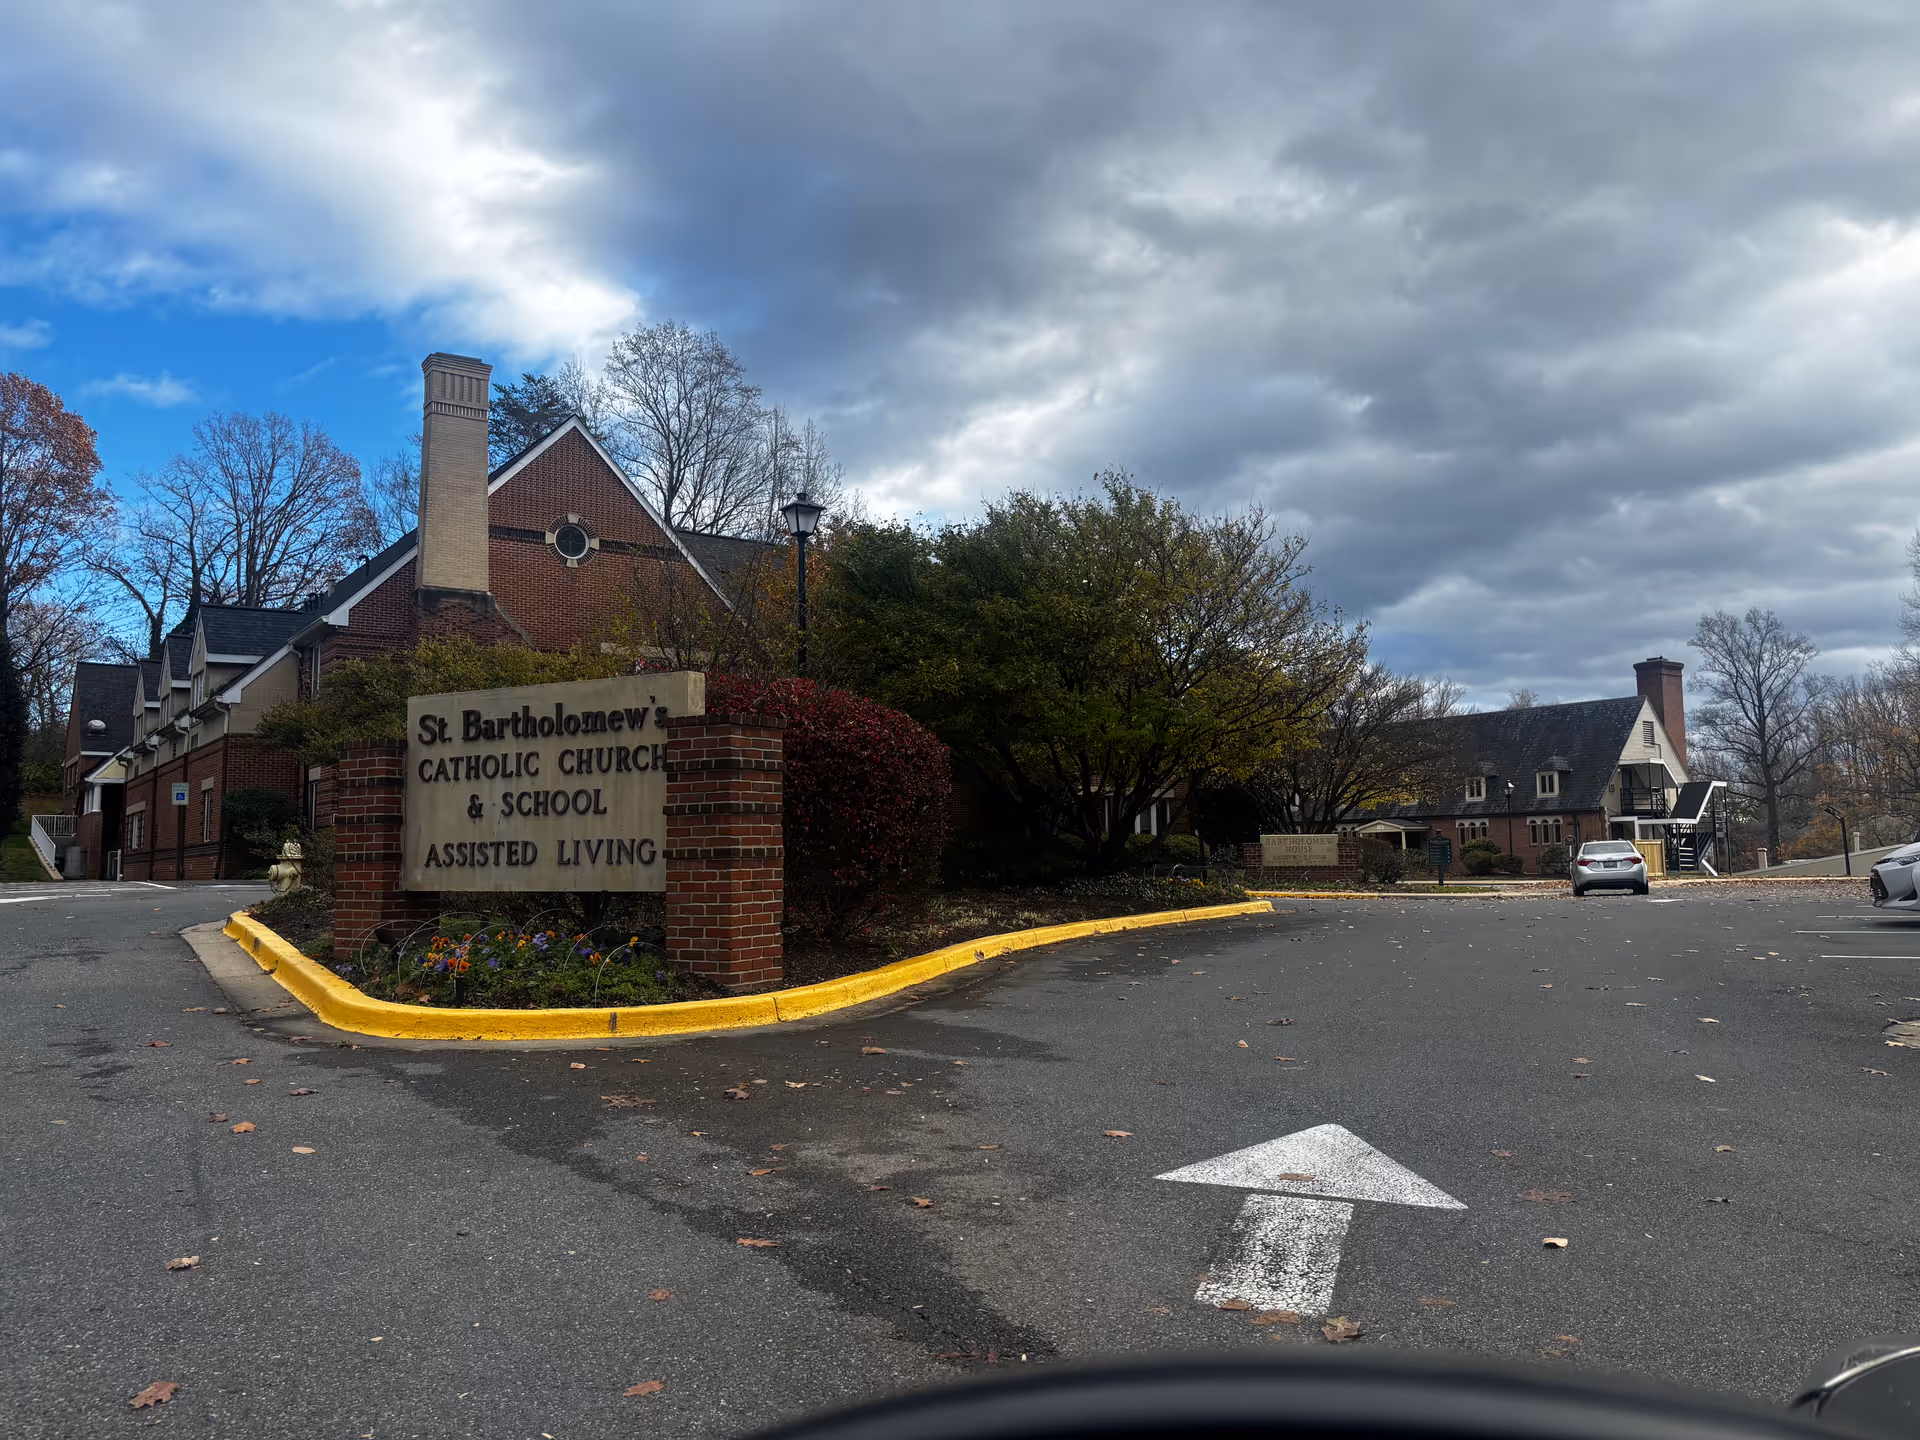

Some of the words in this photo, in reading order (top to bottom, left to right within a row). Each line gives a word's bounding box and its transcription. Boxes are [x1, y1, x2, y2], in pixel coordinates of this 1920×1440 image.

[417, 714, 452, 745] St.
[460, 695, 668, 742] Bartholomew's
[418, 751, 540, 782] CATHOLIC
[558, 743, 667, 775] CHURCH
[467, 794, 484, 819] &
[501, 788, 607, 817] SCHOOL
[424, 841, 538, 868] ASSISTED
[556, 837, 656, 865] LIVING
